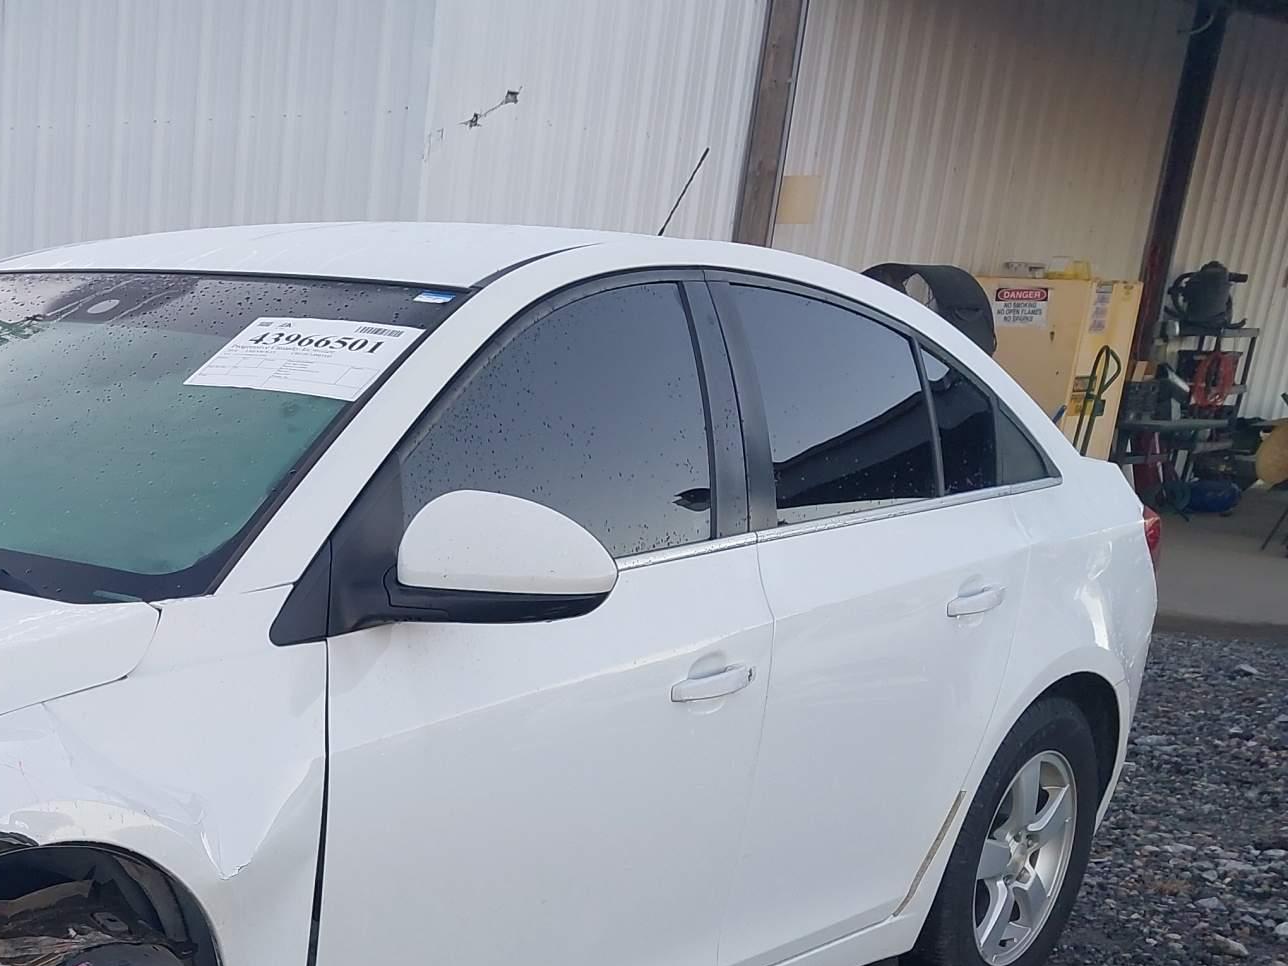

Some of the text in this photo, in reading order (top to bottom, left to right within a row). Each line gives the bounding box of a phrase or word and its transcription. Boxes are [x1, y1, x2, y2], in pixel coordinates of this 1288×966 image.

[1003, 290, 1041, 299] DANGER
[1021, 308, 1042, 316] FLAMES
[248, 331, 385, 354] 43966501
